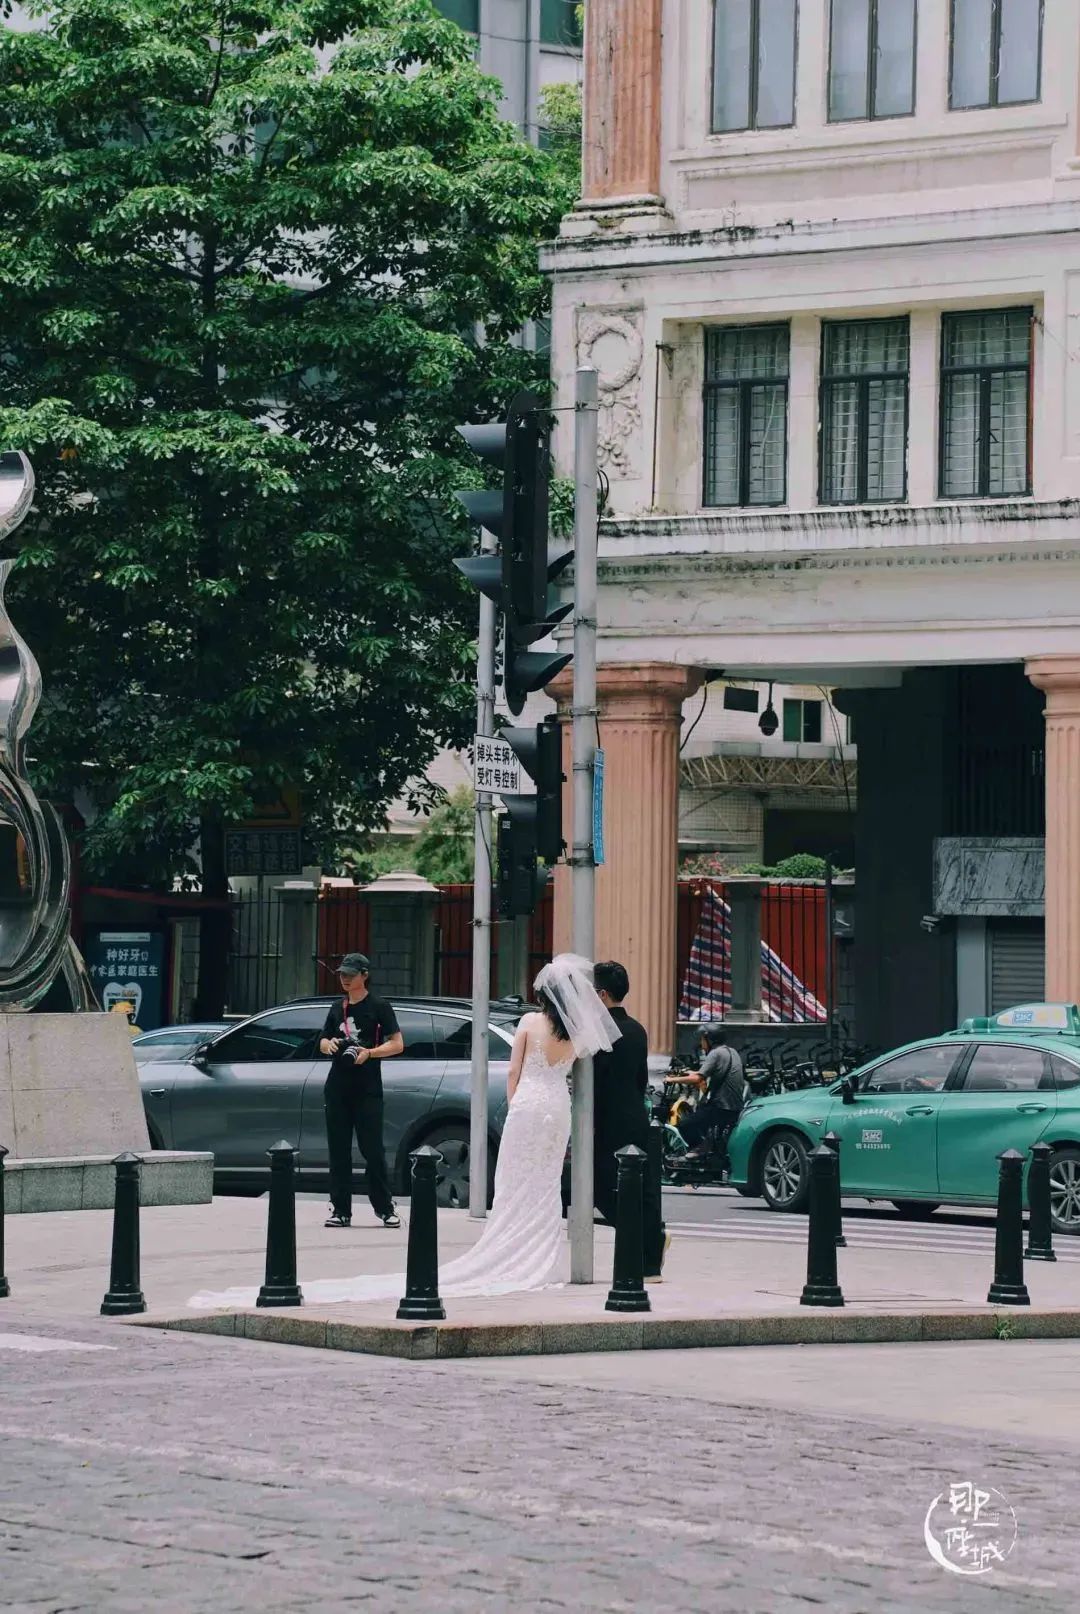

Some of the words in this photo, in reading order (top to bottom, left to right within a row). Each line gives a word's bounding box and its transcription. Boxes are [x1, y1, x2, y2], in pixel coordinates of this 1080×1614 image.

[477, 767, 518, 789] 受灯号控制
